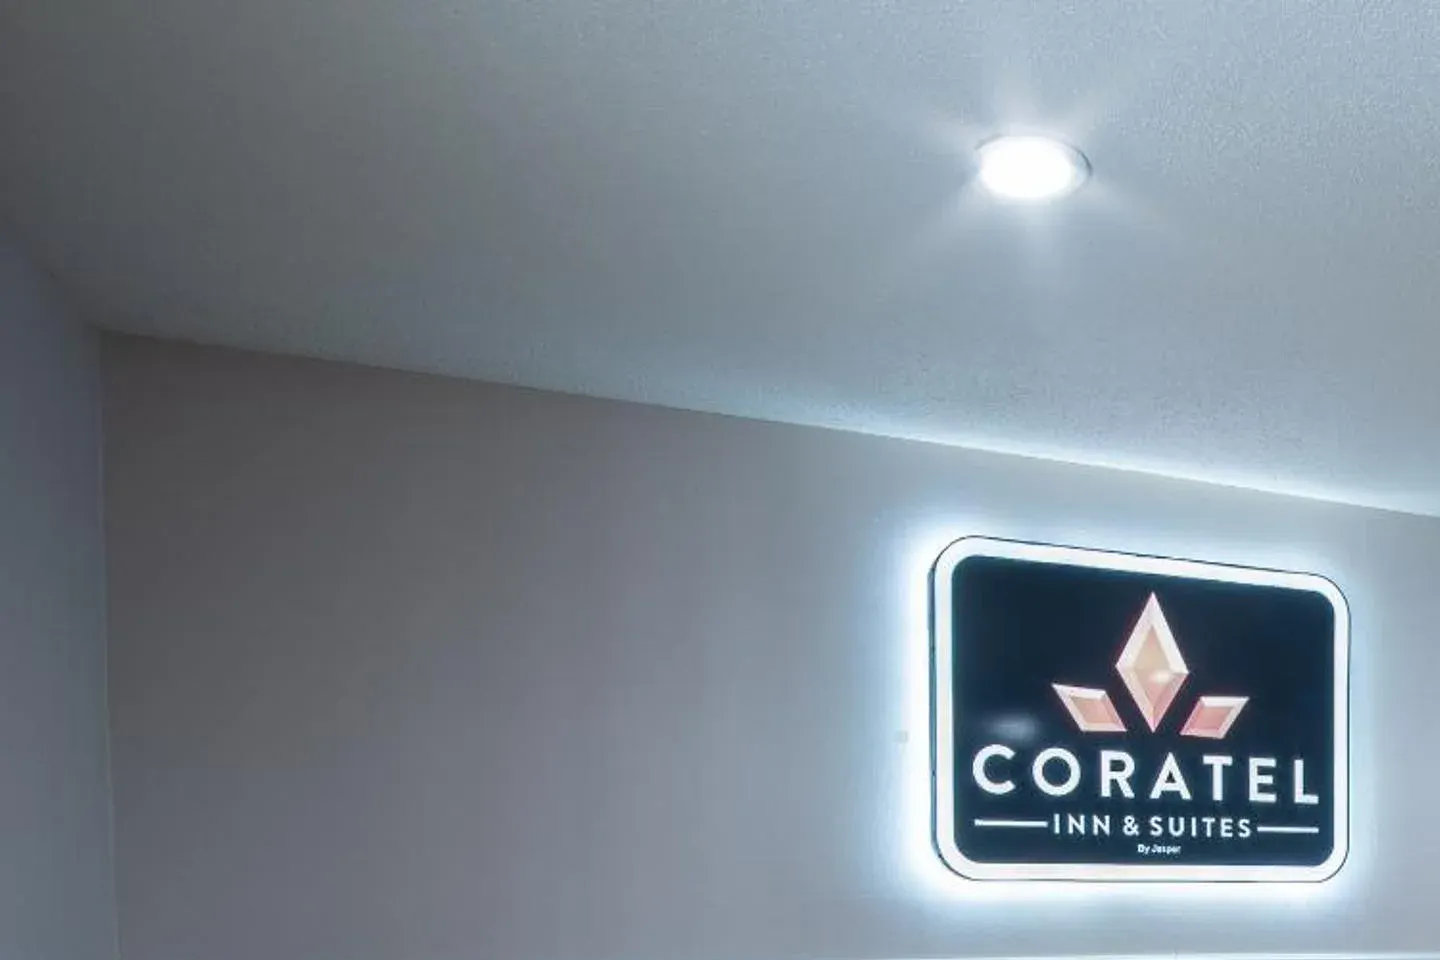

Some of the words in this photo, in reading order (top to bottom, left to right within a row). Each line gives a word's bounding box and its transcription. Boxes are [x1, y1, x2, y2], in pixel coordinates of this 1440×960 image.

[972, 744, 1319, 804] CORATEL
[1053, 813, 1111, 837] INN
[1122, 815, 1140, 837] &
[1150, 816, 1252, 838] SUITES
[1137, 843, 1151, 855] By
